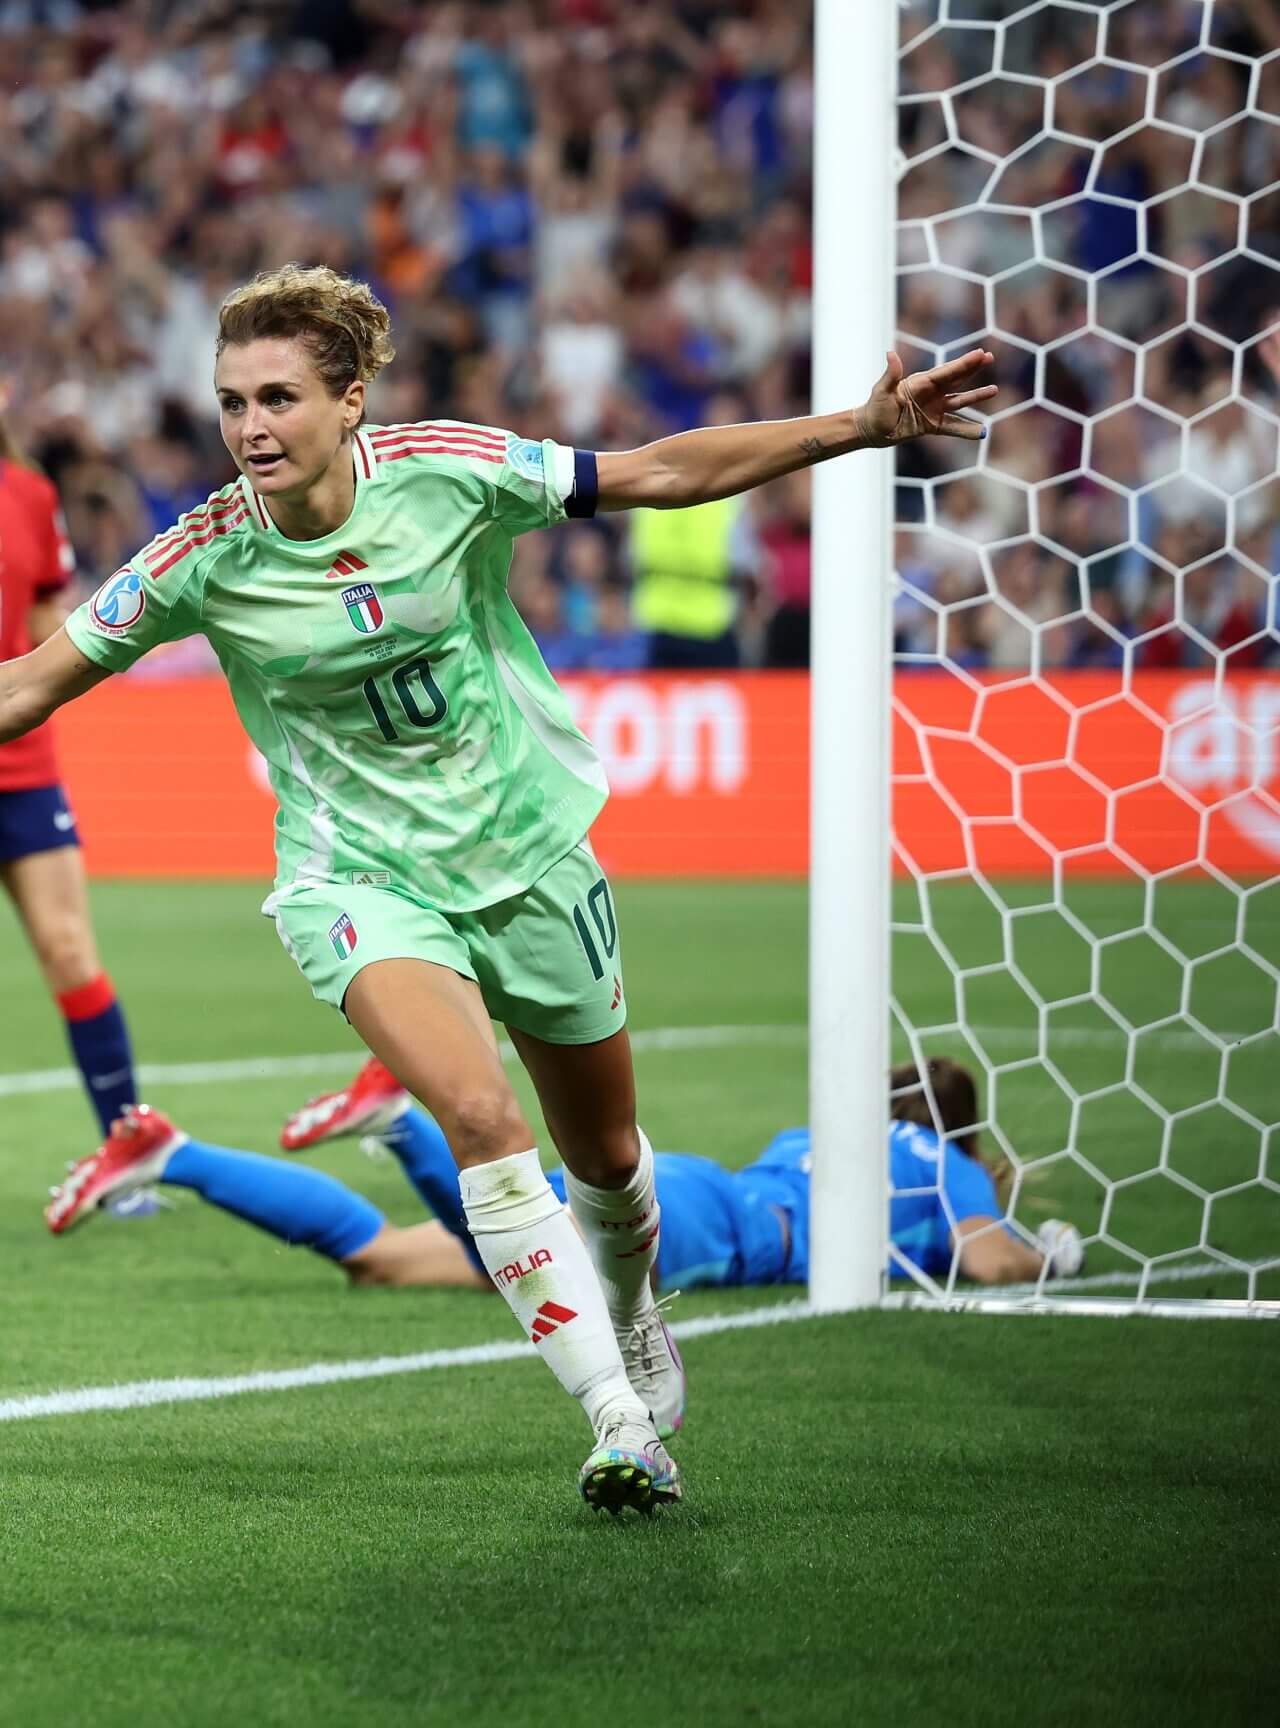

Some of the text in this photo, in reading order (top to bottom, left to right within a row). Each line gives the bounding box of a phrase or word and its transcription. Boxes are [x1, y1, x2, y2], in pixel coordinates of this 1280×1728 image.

[342, 585, 373, 603] ITALIA
[362, 657, 448, 742] 10
[329, 916, 349, 941] ITALIA
[573, 877, 617, 982] 10
[494, 1249, 552, 1288] ITALIA
